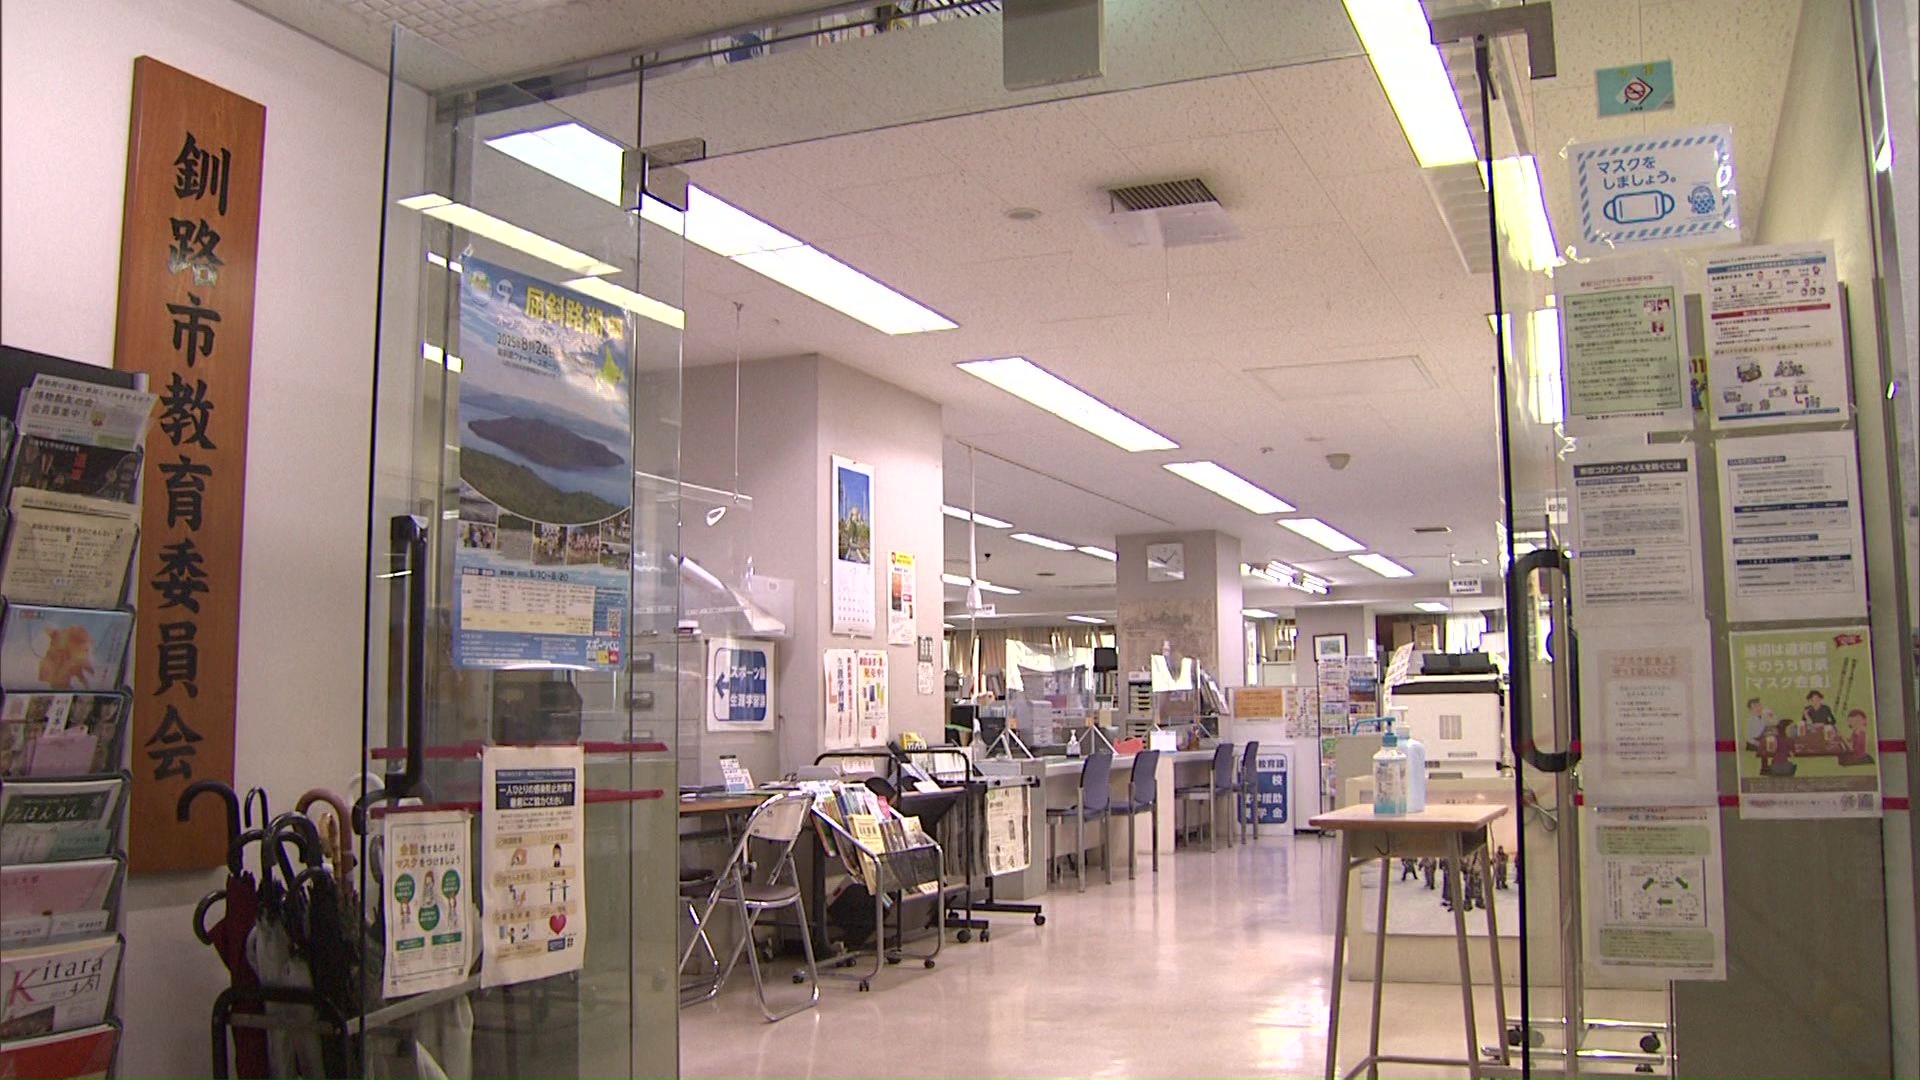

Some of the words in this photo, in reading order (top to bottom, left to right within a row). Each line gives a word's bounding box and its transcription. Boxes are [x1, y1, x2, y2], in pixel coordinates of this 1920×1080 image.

[1597, 156, 1656, 174] マスクを
[1603, 171, 1678, 190] しましょう。
[144, 131, 231, 780] 釧路市教育委員会
[8, 955, 104, 1007] Kitara
